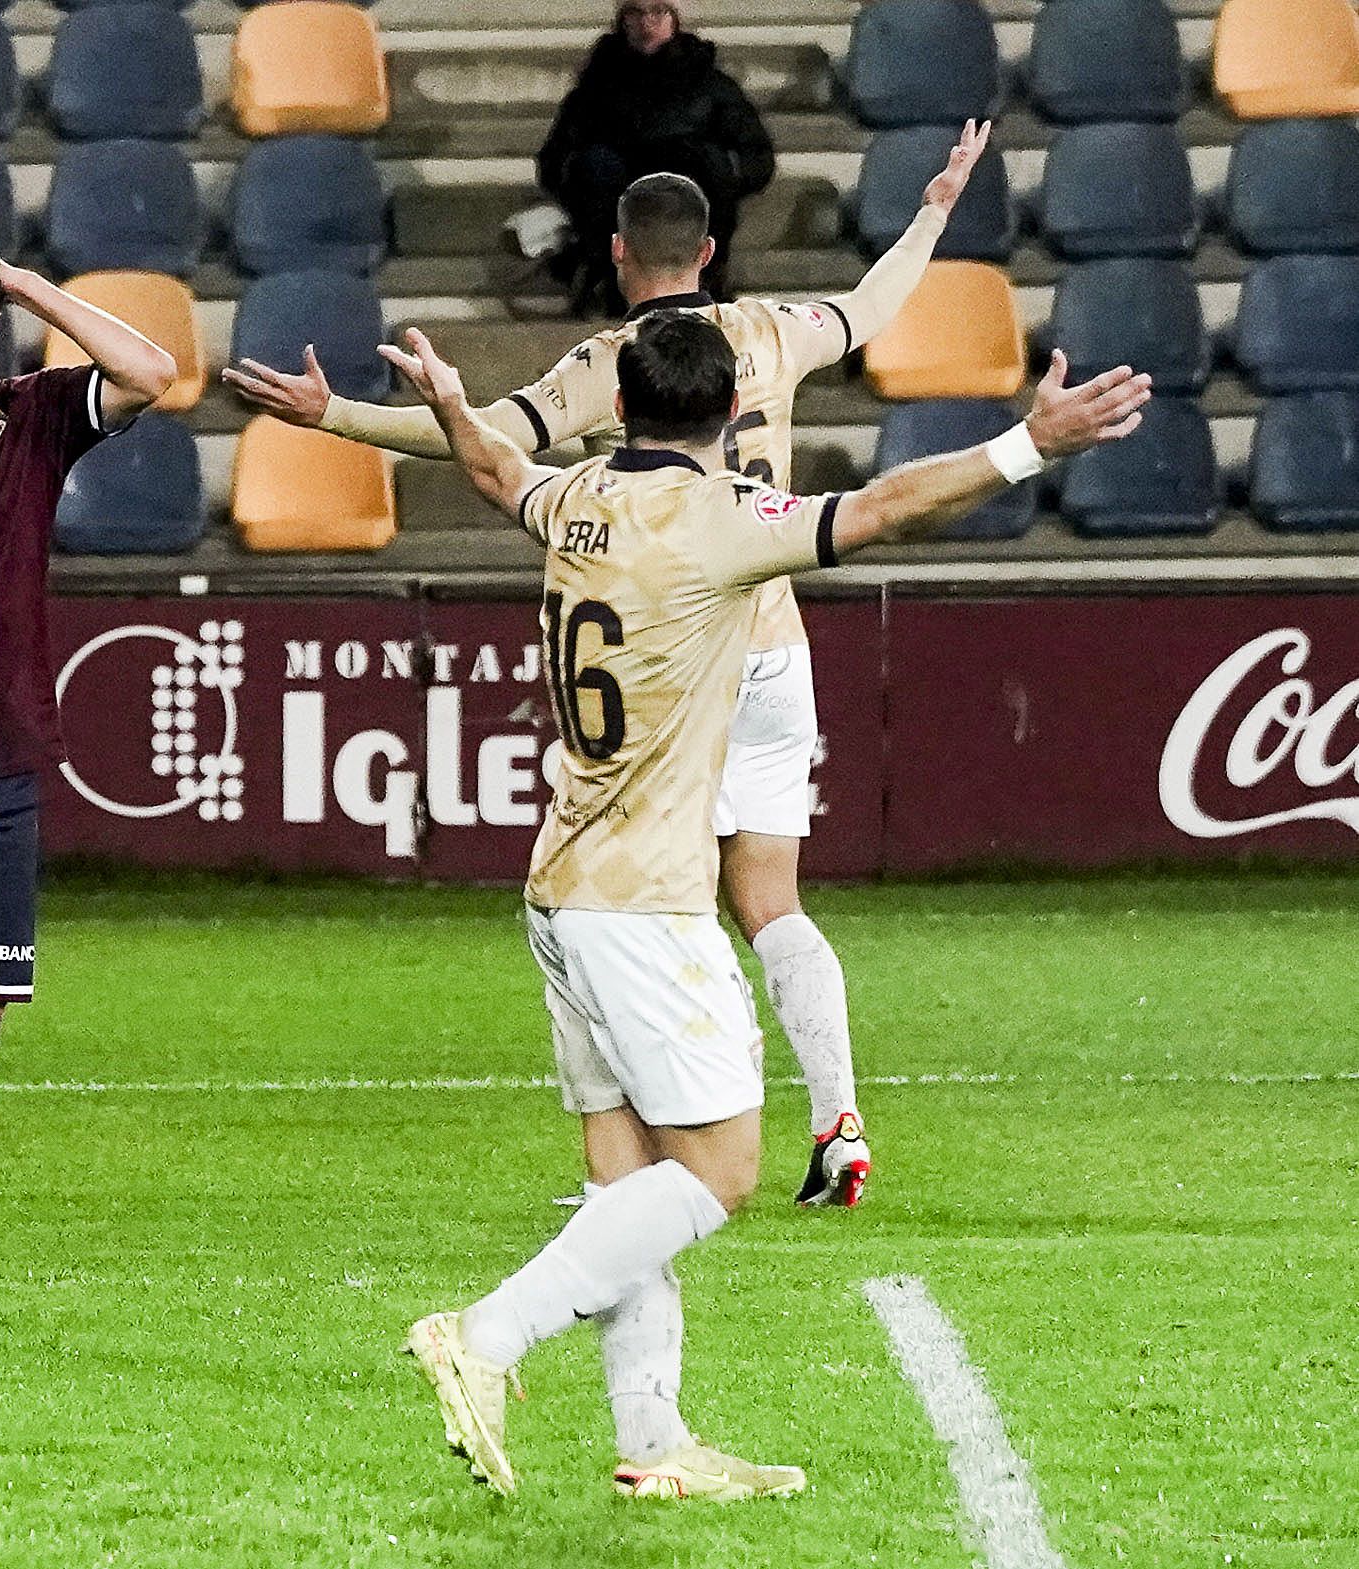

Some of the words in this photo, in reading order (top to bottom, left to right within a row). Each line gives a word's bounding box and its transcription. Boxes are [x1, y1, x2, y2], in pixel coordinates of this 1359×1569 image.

[560, 521, 609, 554] ERA
[284, 639, 541, 683] MONTAJ
[546, 589, 625, 760] 16
[1158, 627, 1359, 838] Coc
[282, 684, 562, 858] IGLE
